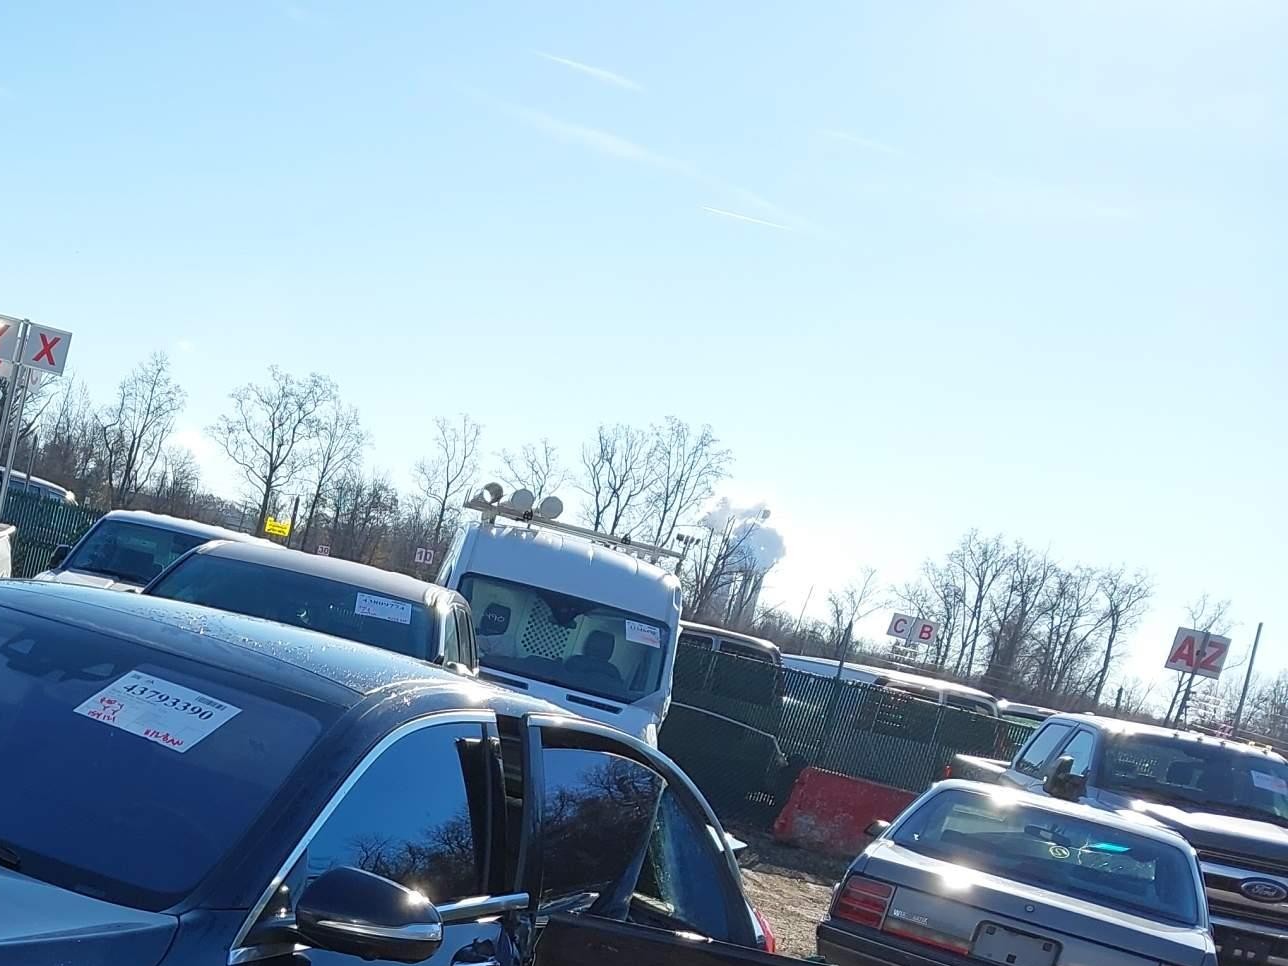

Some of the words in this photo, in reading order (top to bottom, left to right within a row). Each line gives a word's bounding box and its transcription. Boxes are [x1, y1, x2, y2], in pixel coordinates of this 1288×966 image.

[32, 332, 61, 366] X
[893, 618, 908, 634] C
[918, 623, 934, 640] B
[123, 684, 214, 720] 43793390
